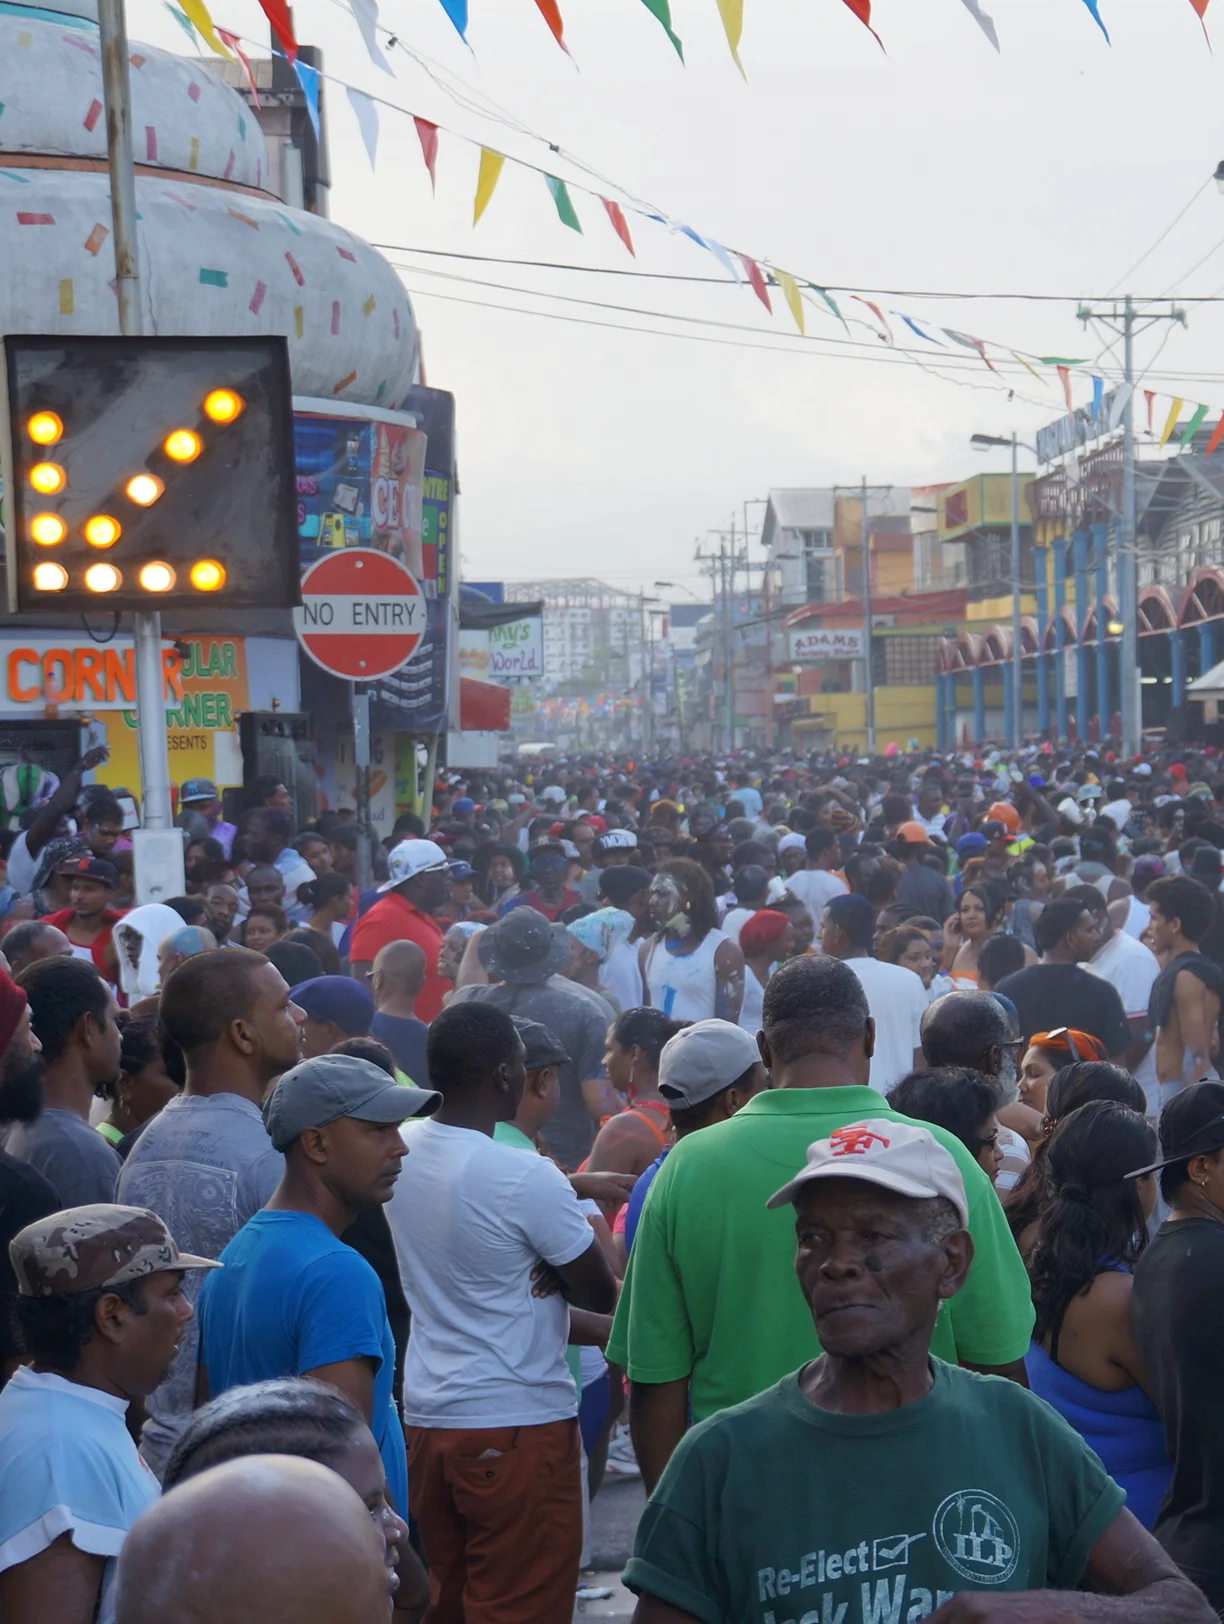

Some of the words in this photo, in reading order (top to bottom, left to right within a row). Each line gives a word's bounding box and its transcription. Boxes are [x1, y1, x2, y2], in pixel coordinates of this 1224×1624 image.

[304, 602, 334, 626] NO
[352, 602, 416, 626] ENTRY
[795, 633, 859, 649] ADAMS
[8, 647, 184, 702] CORNR
[757, 1540, 869, 1602] Re-Elect
